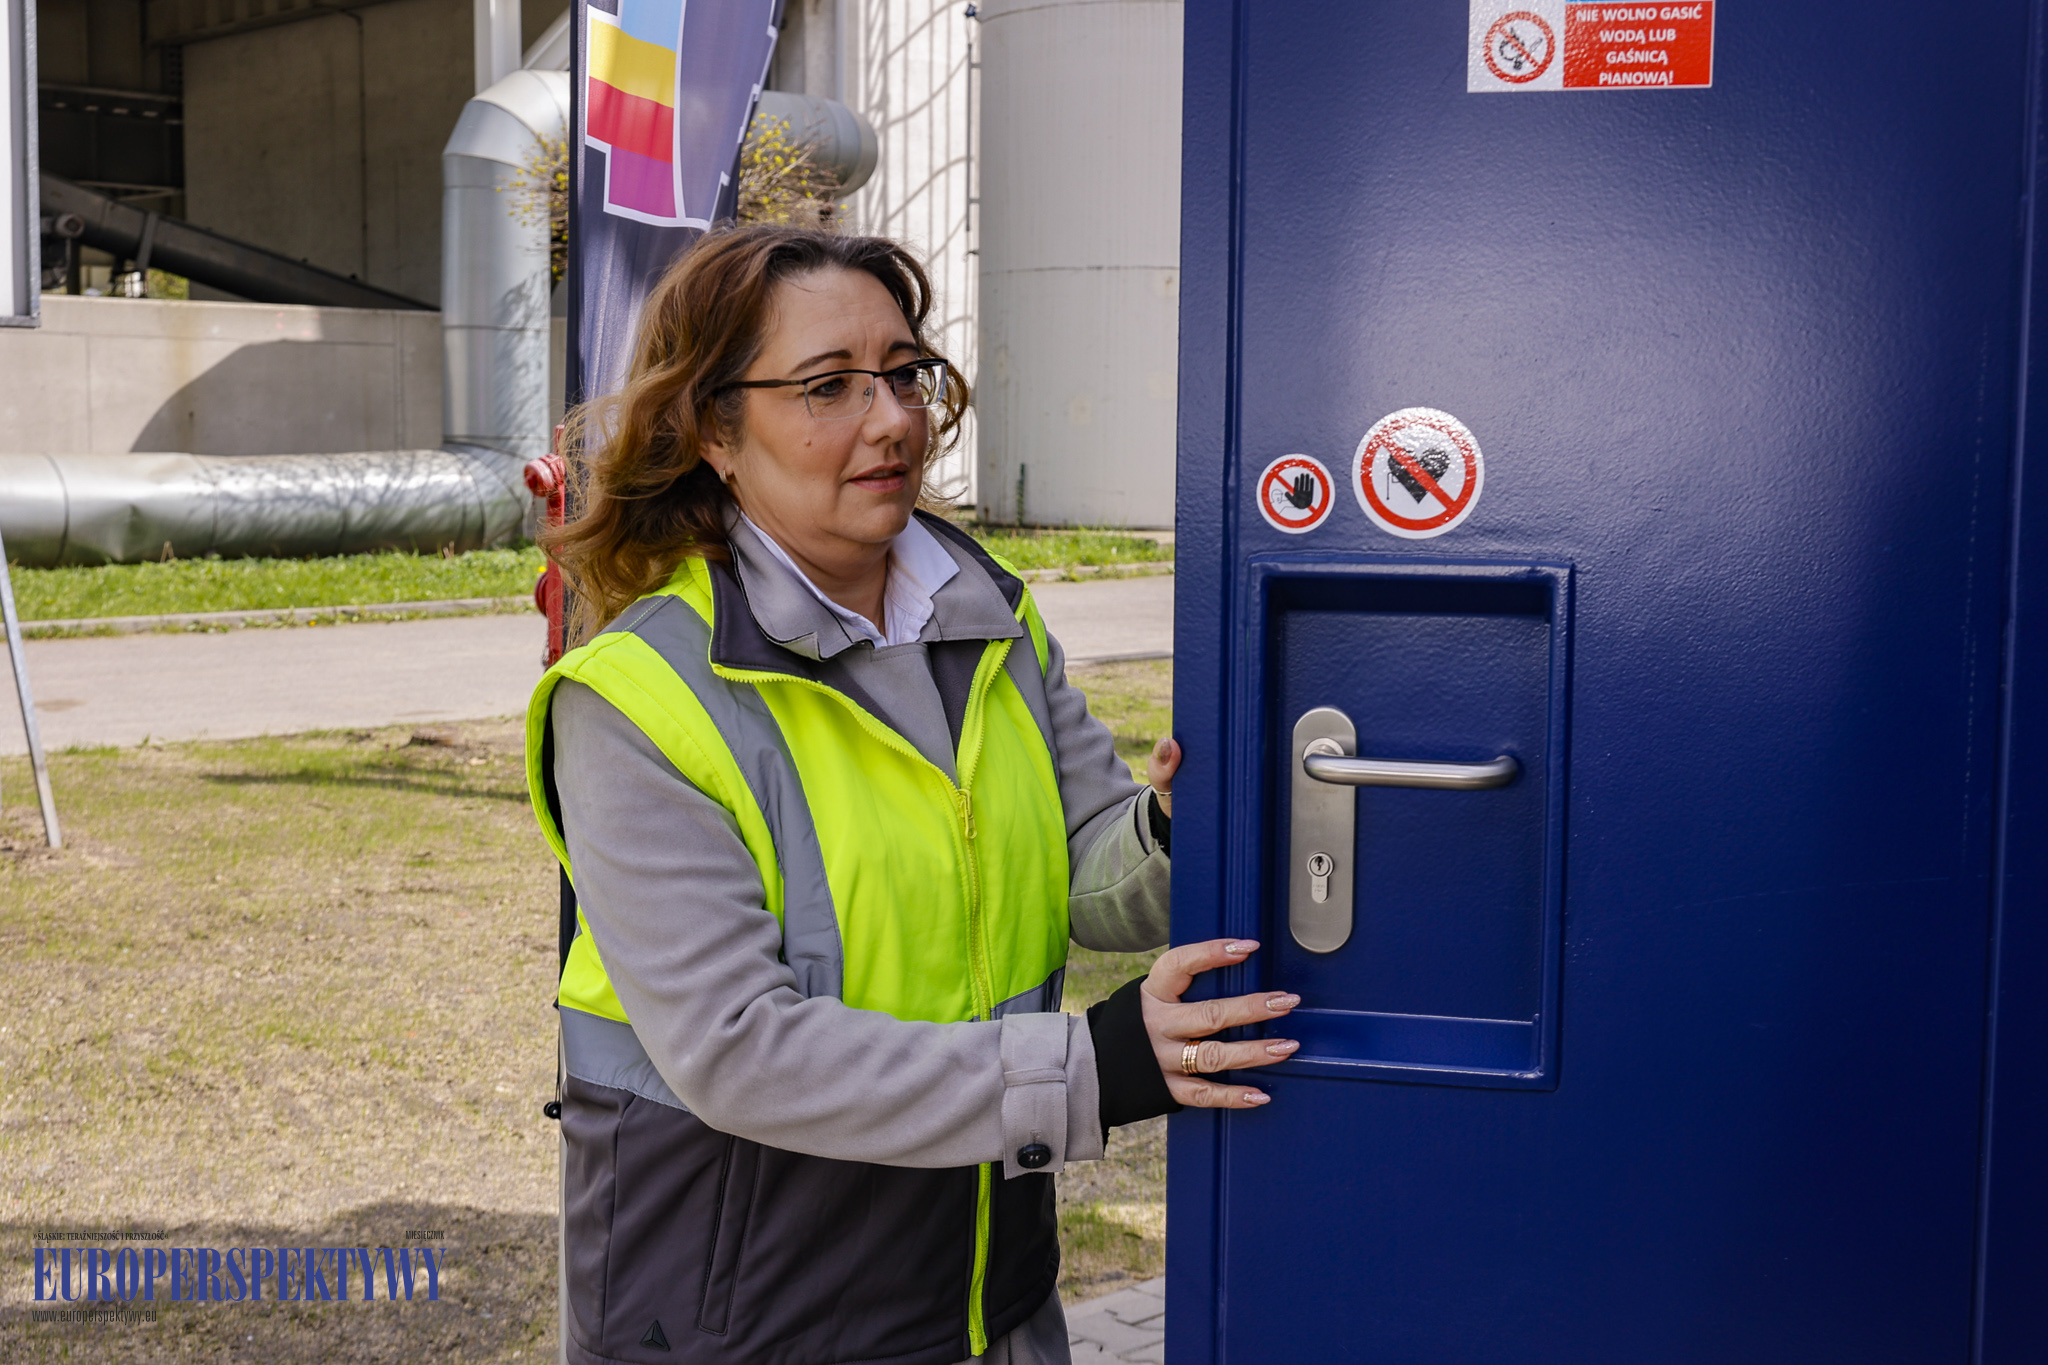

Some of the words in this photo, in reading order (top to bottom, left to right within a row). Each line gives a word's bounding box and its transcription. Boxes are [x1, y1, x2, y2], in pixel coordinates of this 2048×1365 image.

[1576, 9, 1599, 22] NIE
[1602, 7, 1657, 21] WOLNO
[1660, 3, 1702, 20] GASIĆ
[1599, 29, 1646, 44] WODĄ
[1649, 28, 1676, 41] LUB
[1606, 48, 1668, 65] GAŚNICĄ
[1599, 70, 1673, 86] PIANOWĄ!
